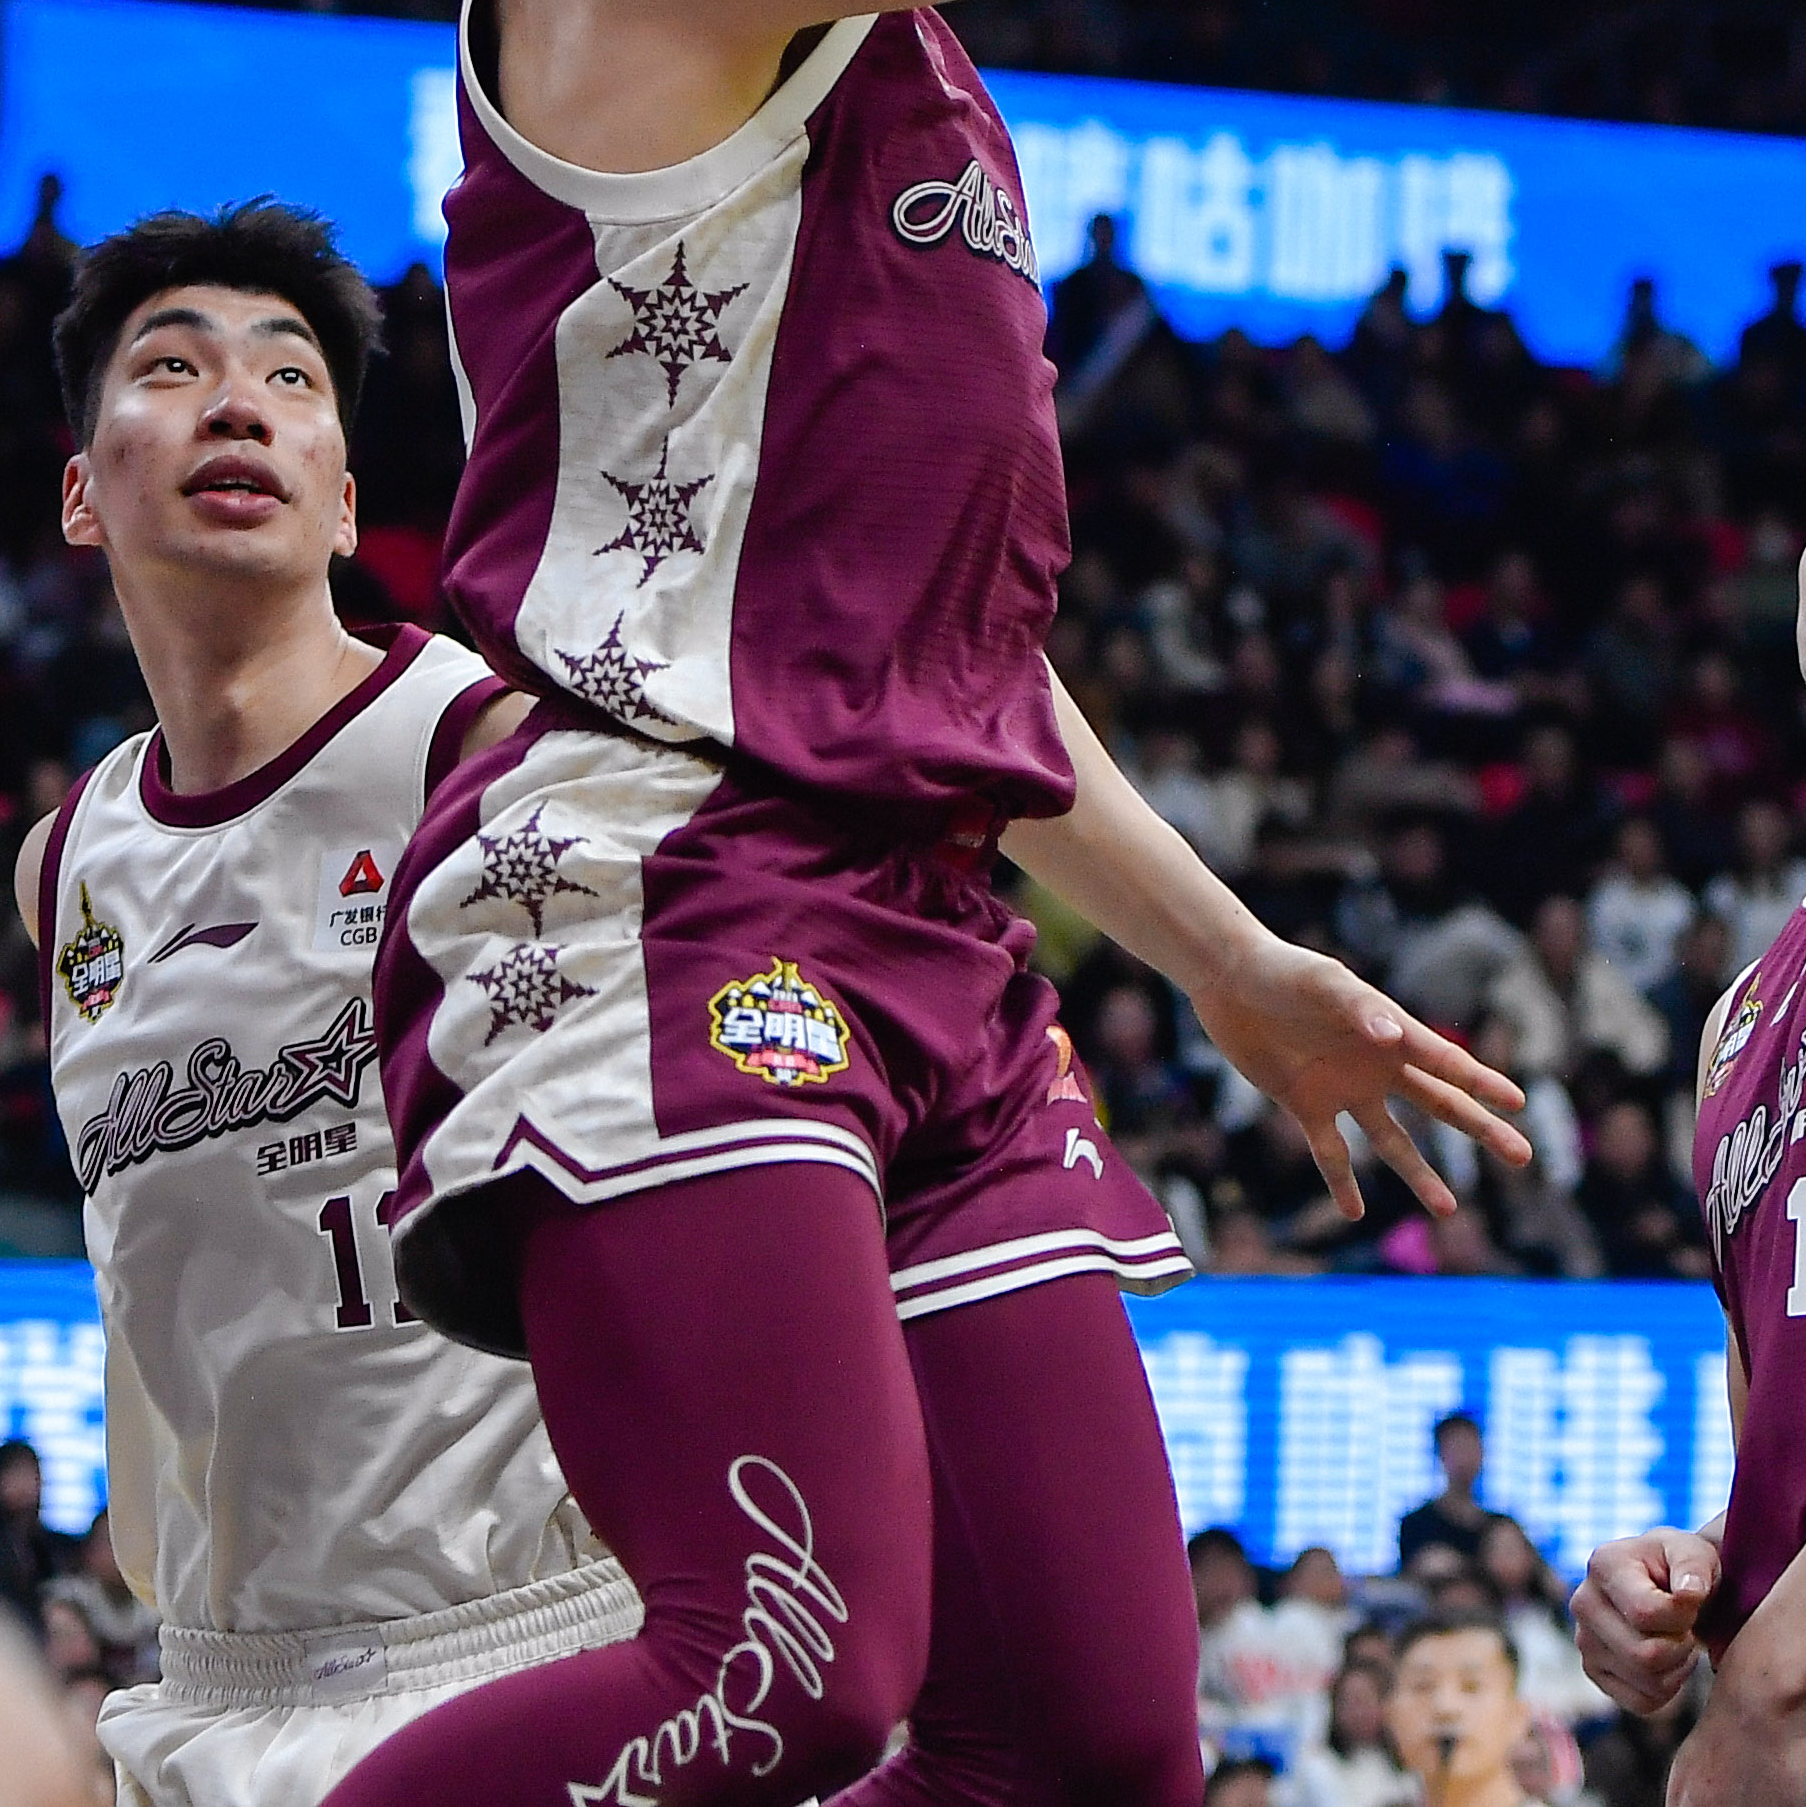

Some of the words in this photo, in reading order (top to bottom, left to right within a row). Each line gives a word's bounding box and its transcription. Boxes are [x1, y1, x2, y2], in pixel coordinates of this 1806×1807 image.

[340, 926, 378, 946] CGB
[256, 1122, 358, 1177] 全明星
